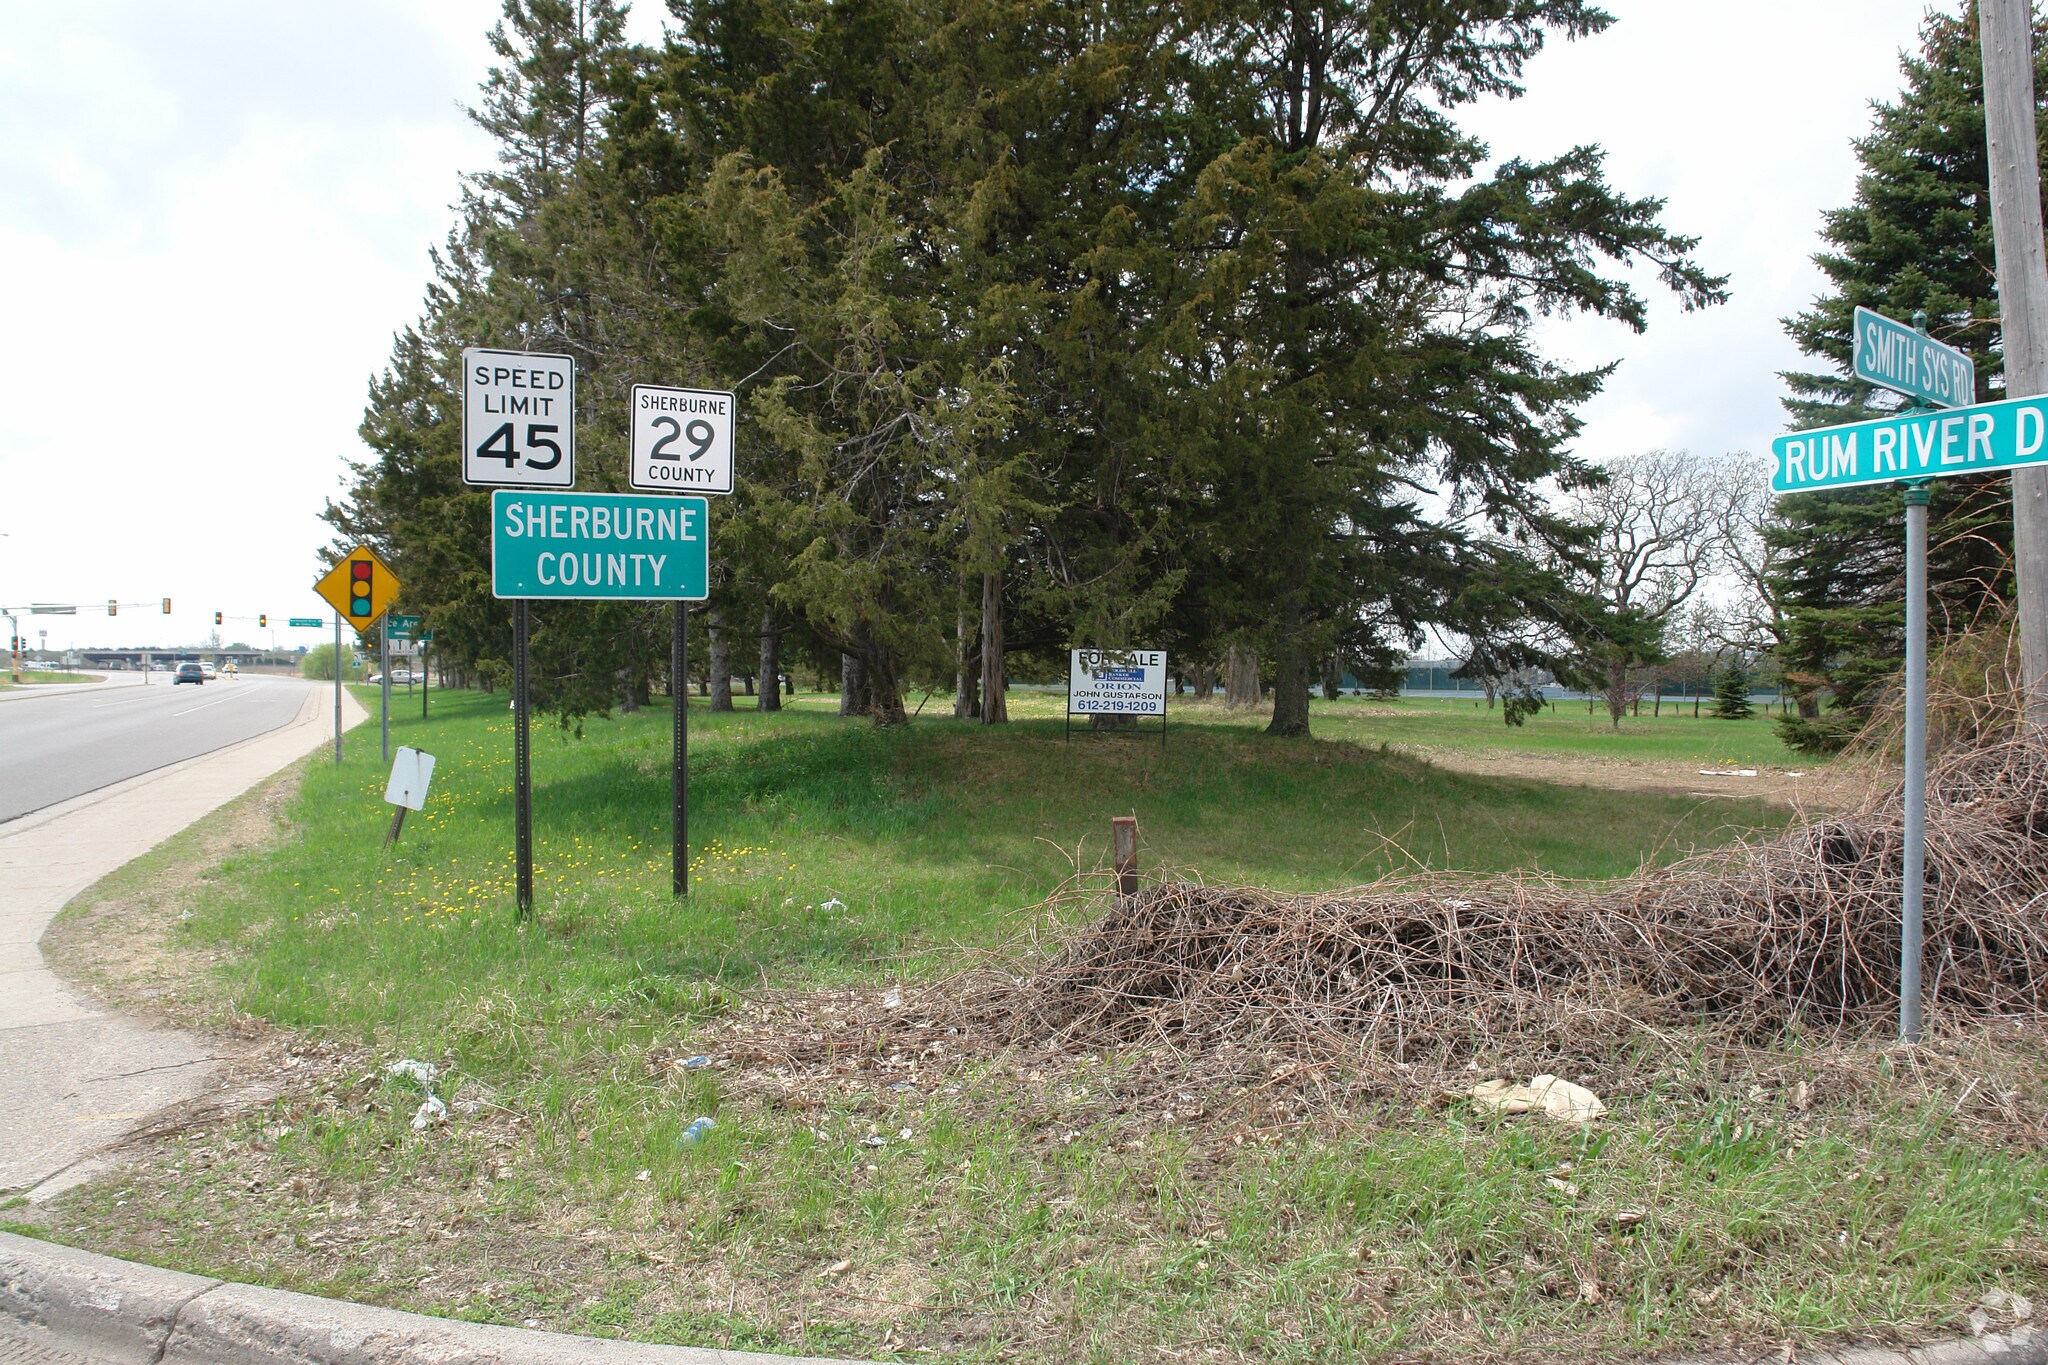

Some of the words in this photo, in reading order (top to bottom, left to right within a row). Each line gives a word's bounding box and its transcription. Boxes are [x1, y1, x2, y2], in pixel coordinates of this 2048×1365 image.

[1865, 321, 1917, 386] SMITH
[1922, 345, 1950, 398] SYS
[1953, 362, 1969, 406] RD
[474, 366, 564, 390] SPEED
[484, 394, 554, 417] LIMIT
[641, 394, 726, 416] SHERBURNE
[476, 422, 562, 471] 45
[650, 415, 715, 462] 29
[1785, 432, 1857, 484] RUM
[1873, 413, 1994, 473] RIVER
[2015, 406, 2045, 457] D
[648, 465, 715, 483] COUNTY
[505, 503, 697, 541] SHERBURNE
[537, 552, 667, 586] COUNTY
[1073, 690, 1100, 698] JOHN
[1103, 691, 1162, 700] GUSTAFSON
[1094, 682, 1142, 690] ORION
[1078, 700, 1157, 712] 612-219-1209
